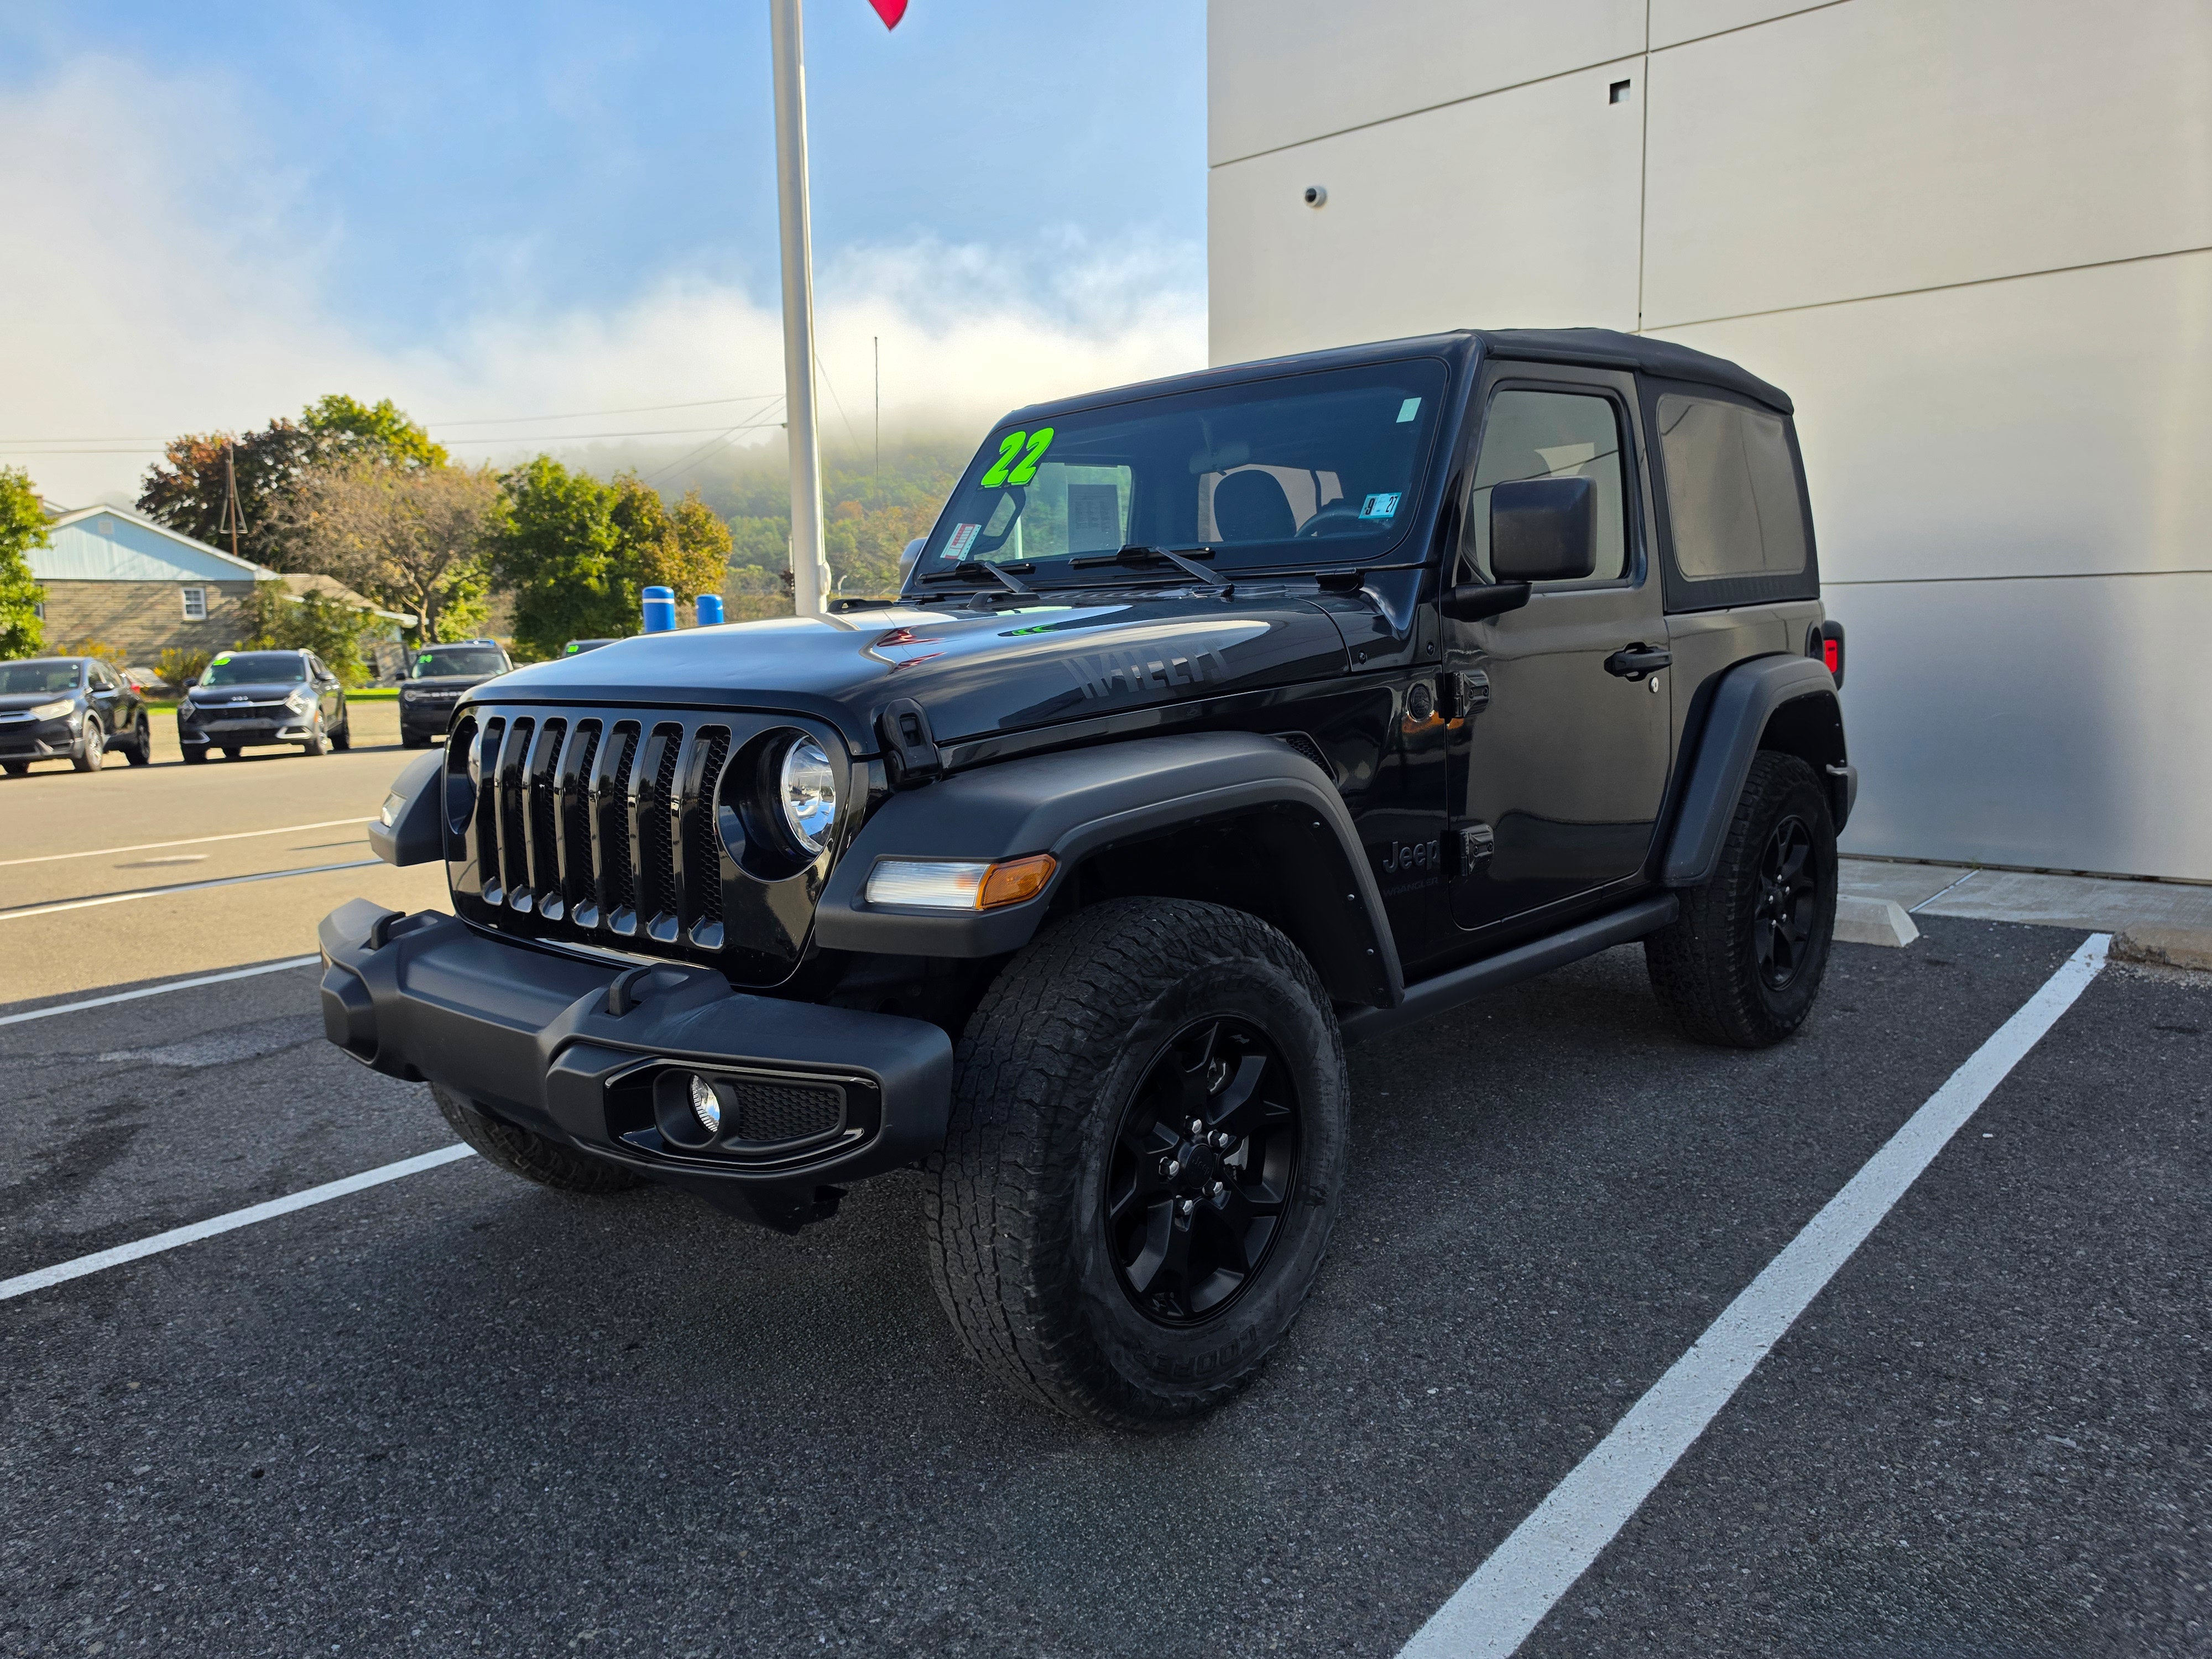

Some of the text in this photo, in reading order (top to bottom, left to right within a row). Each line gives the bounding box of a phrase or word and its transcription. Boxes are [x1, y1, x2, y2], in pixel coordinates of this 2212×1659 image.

[980, 427, 1055, 488] 22
[1385, 496, 1399, 513] 27
[1383, 839, 1440, 873] Jeep
[1383, 877, 1438, 898] WRANGLER
